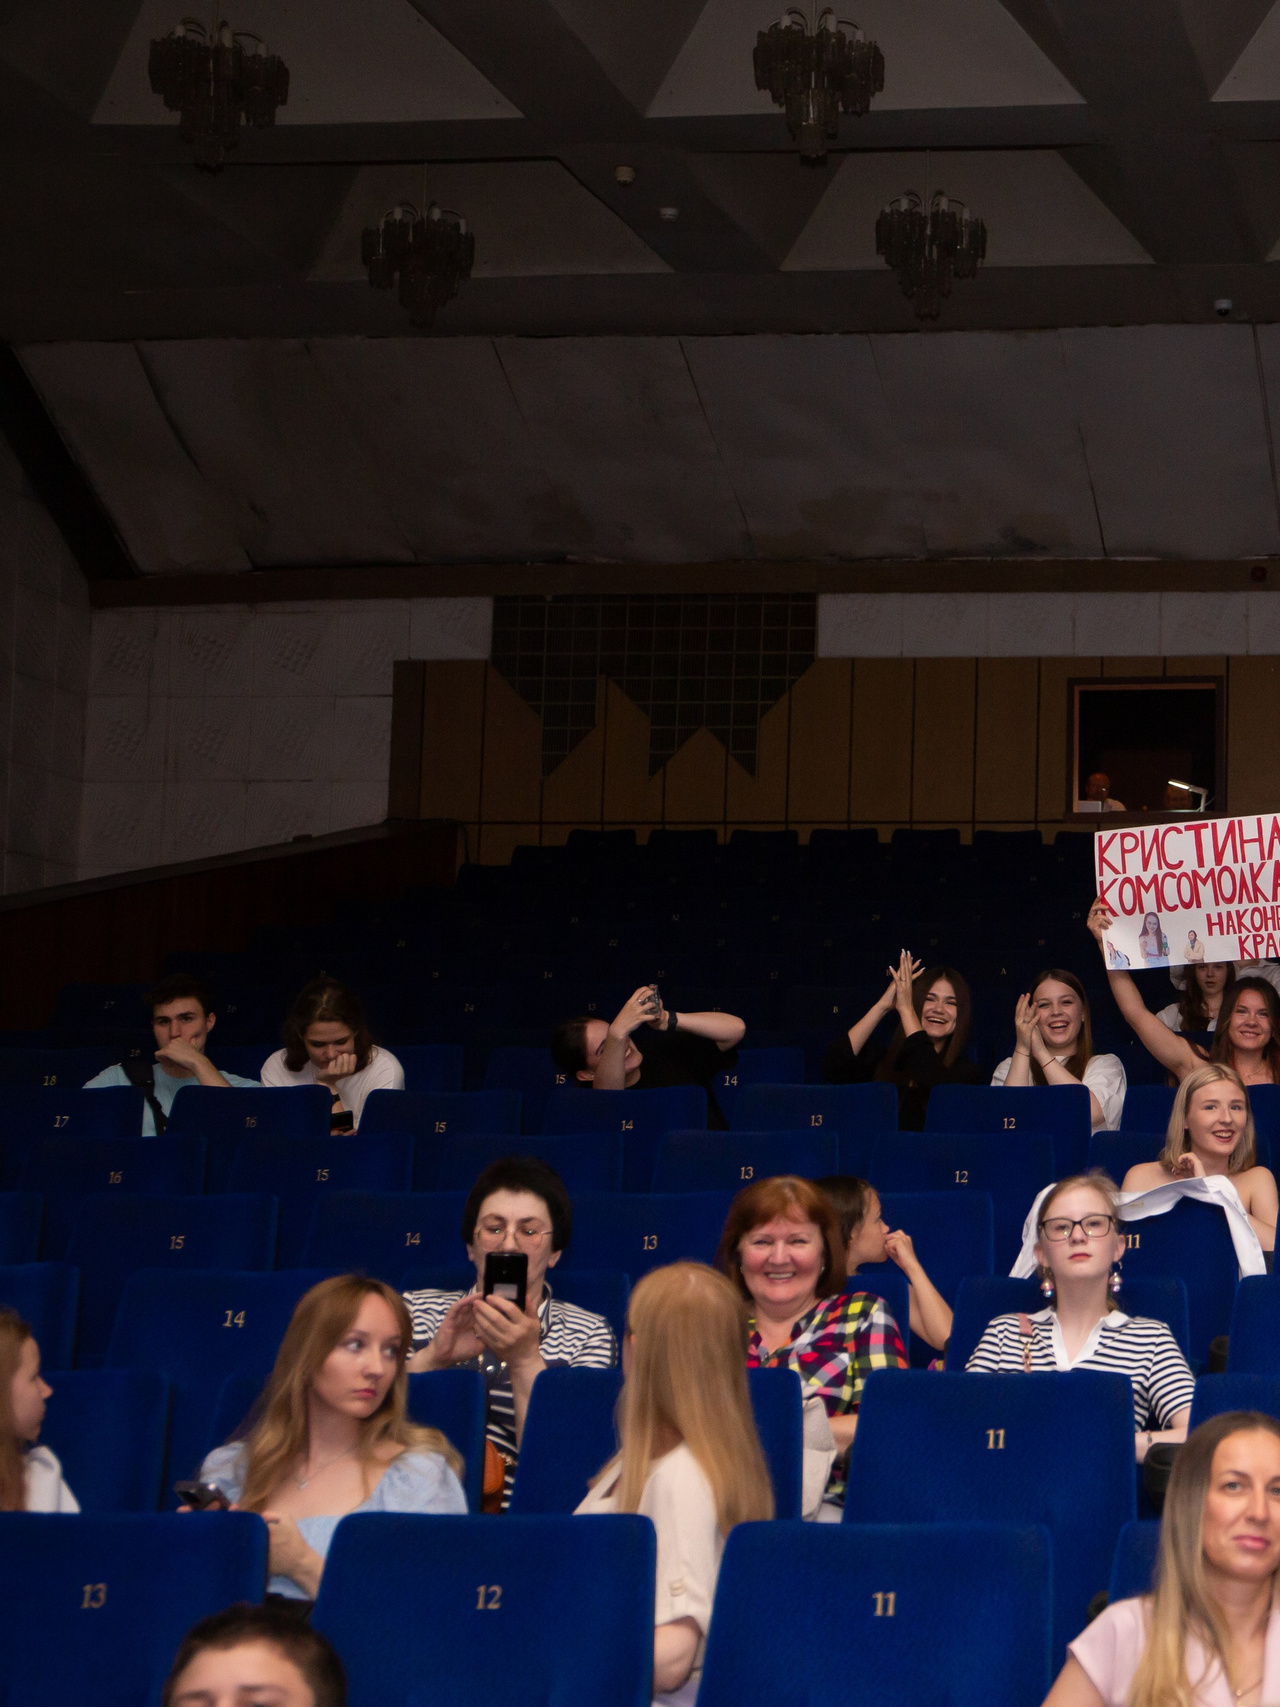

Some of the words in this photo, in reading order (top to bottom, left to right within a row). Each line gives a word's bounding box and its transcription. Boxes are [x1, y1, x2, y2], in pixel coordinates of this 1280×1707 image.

[42, 1075, 57, 1087] 18
[555, 1074, 566, 1085] 15
[723, 1075, 738, 1087] 14
[53, 1115, 70, 1128] 17
[245, 1116, 257, 1128] 16
[435, 1121, 447, 1133] 15
[621, 1119, 634, 1131] 14
[810, 1114, 823, 1127] 13
[1003, 1117, 1016, 1130] 12
[109, 1171, 123, 1184] 16
[316, 1168, 330, 1182] 15
[740, 1165, 754, 1180] 13
[954, 1170, 969, 1184] 12
[170, 1235, 185, 1250] 15
[405, 1232, 421, 1247] 14
[642, 1234, 658, 1251] 13
[1125, 1233, 1141, 1249] 11
[222, 1309, 246, 1328] 14
[986, 1428, 1005, 1450] 11
[80, 1582, 108, 1609] 13
[475, 1584, 503, 1611] 12
[872, 1591, 896, 1617] 11
